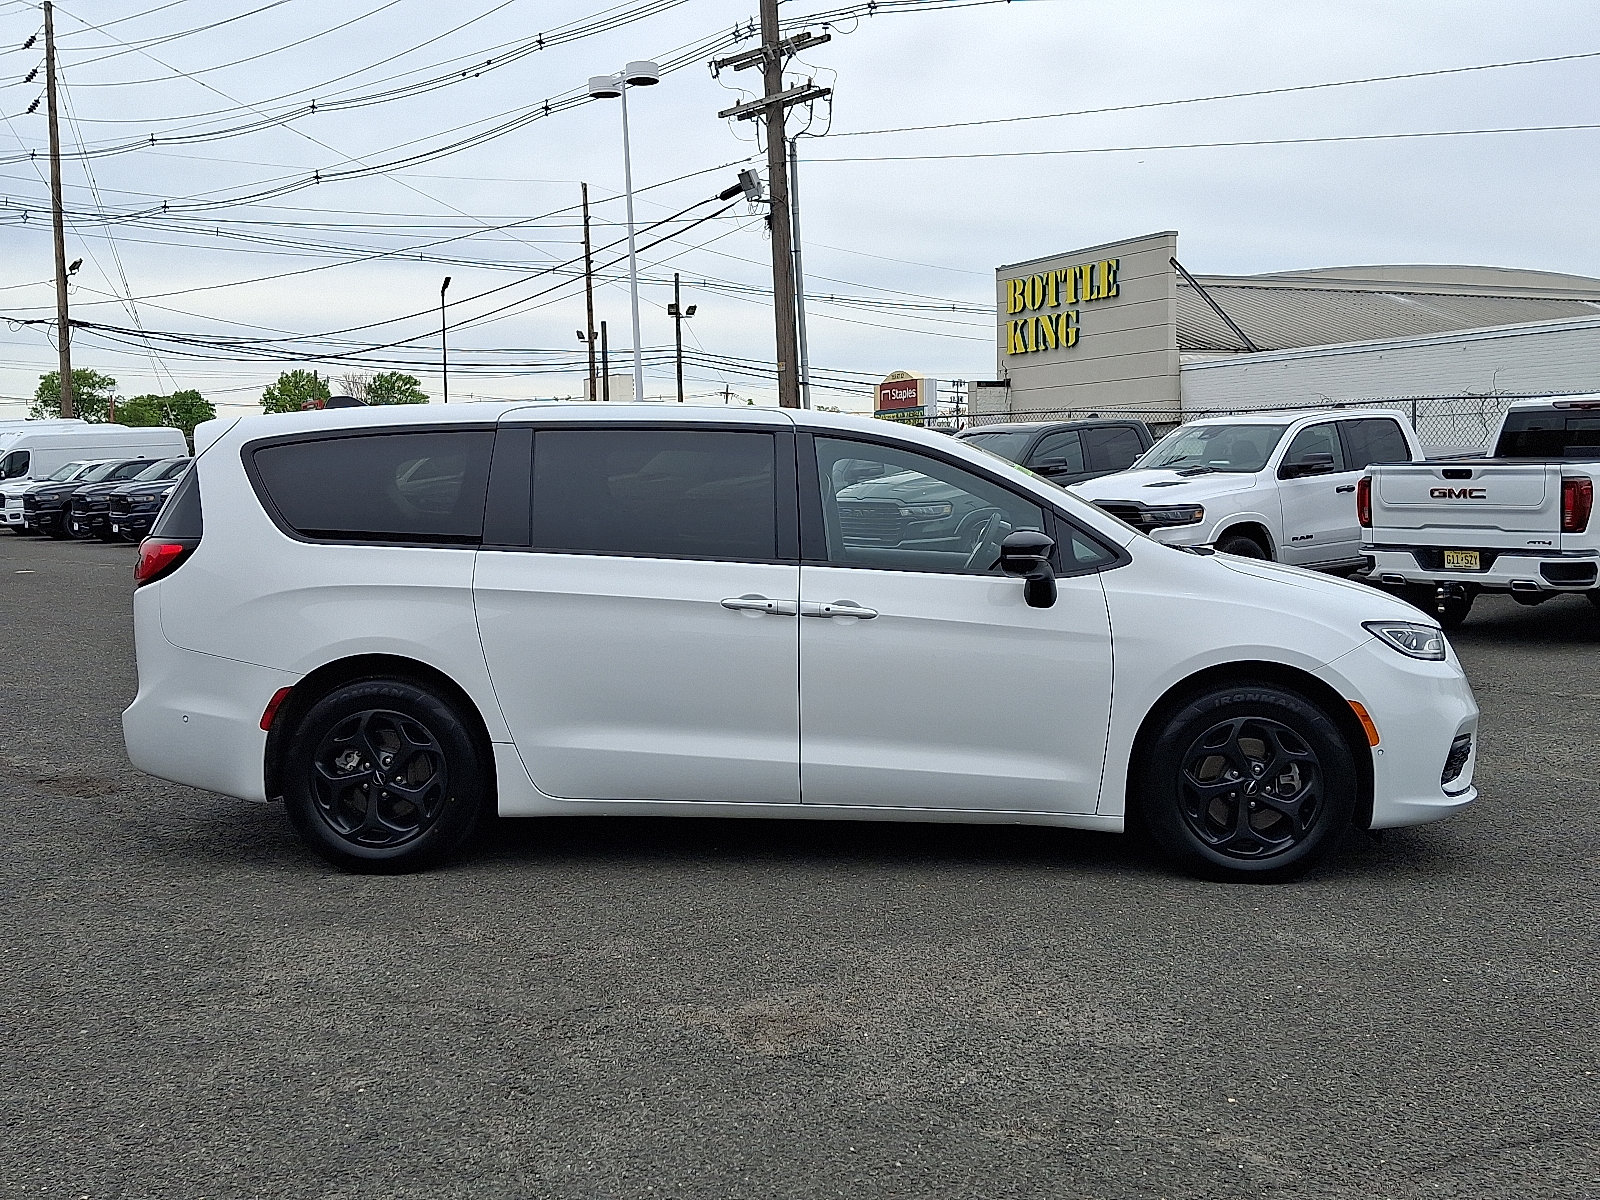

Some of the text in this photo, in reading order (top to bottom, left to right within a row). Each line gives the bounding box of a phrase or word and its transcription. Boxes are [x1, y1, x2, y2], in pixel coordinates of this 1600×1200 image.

[1006, 259, 1119, 314] BOTTLE
[1006, 310, 1080, 354] KING
[891, 387, 917, 402] Staples
[1429, 487, 1486, 499] GMC
[1291, 534, 1314, 542] RAM
[1214, 692, 1301, 712] IRONMAN
